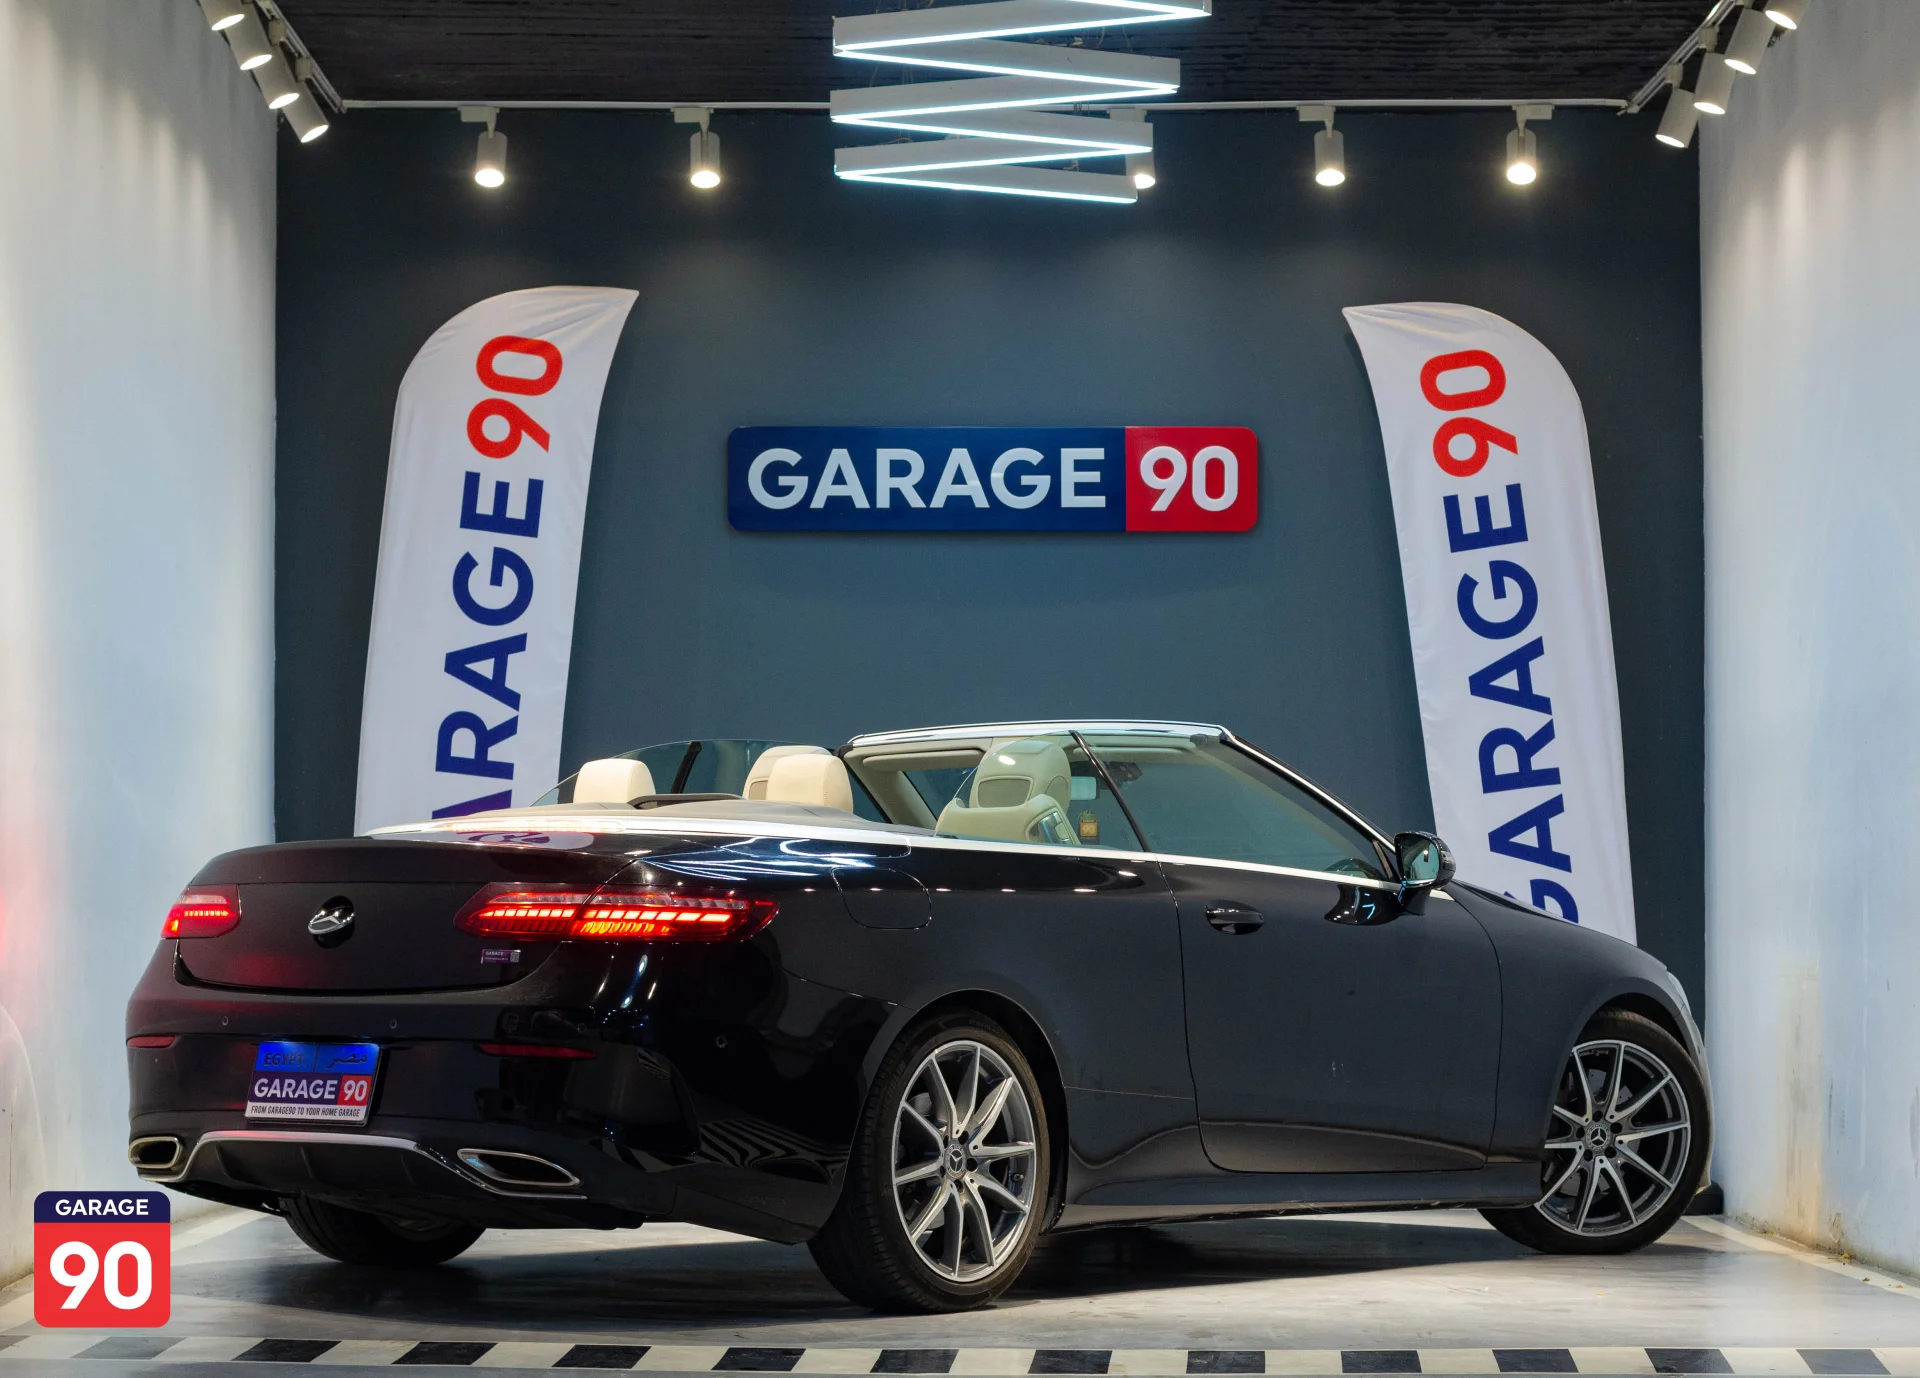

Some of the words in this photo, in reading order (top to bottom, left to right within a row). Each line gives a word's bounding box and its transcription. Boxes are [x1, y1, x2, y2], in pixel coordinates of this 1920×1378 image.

[466, 334, 563, 460] 90
[1419, 349, 1519, 478] 90
[747, 447, 1106, 509] GARAGE
[1139, 445, 1238, 512] 90
[264, 1053, 304, 1067] EGYPT
[324, 1053, 367, 1069] مصر
[254, 1078, 338, 1099] GARAGE
[343, 1080, 368, 1101] 90
[251, 1105, 267, 1114] FROM
[268, 1106, 296, 1115] GARAGE90
[297, 1107, 304, 1115] TO
[306, 1107, 320, 1116] YOUR
[321, 1108, 337, 1117] HOME
[338, 1109, 360, 1118] GARAGE
